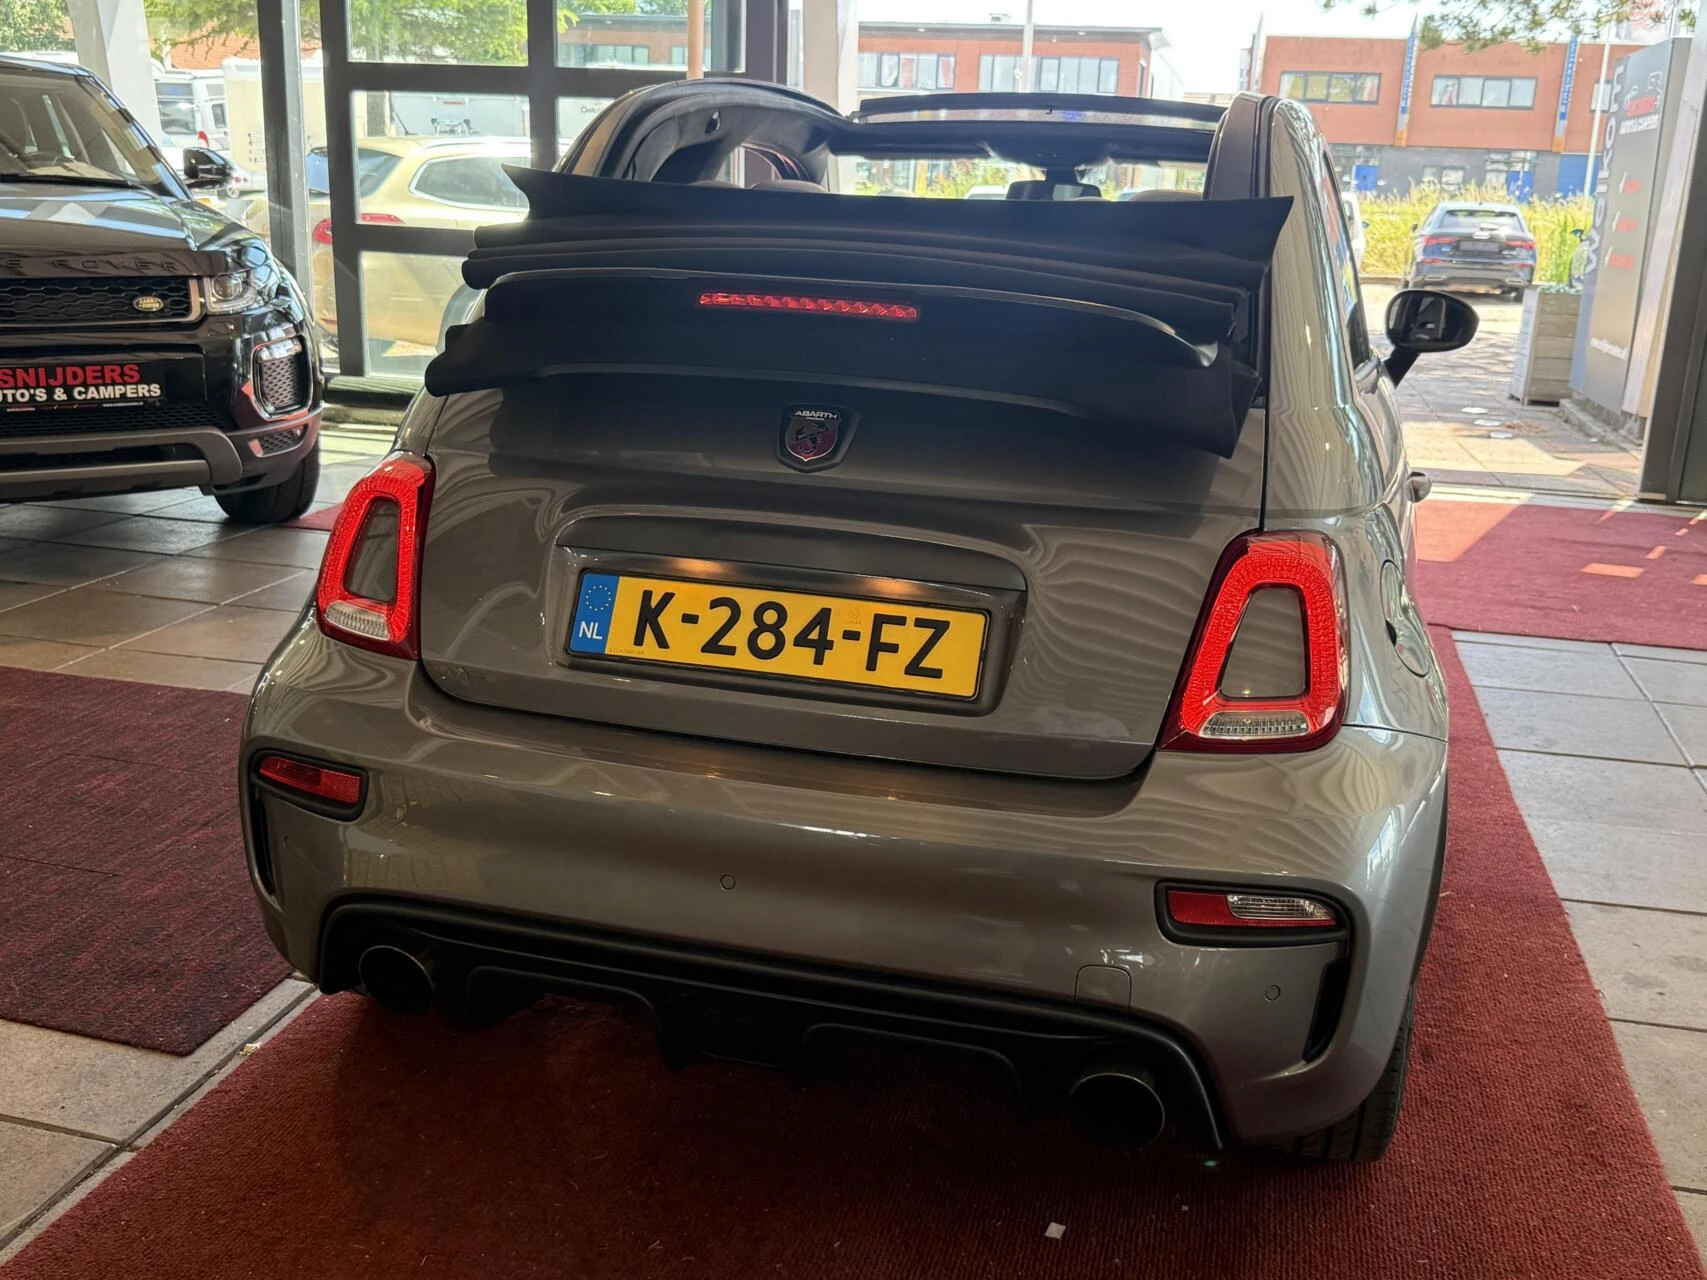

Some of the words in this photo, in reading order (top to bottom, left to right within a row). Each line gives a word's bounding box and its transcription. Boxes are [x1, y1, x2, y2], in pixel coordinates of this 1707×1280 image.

[0, 364, 141, 388] SNIJDERS
[53, 387, 68, 401] &
[73, 383, 161, 400] CAMPERS
[794, 410, 838, 419] ABARTH
[578, 620, 603, 640] NL
[633, 589, 951, 679] K-284-FZ
